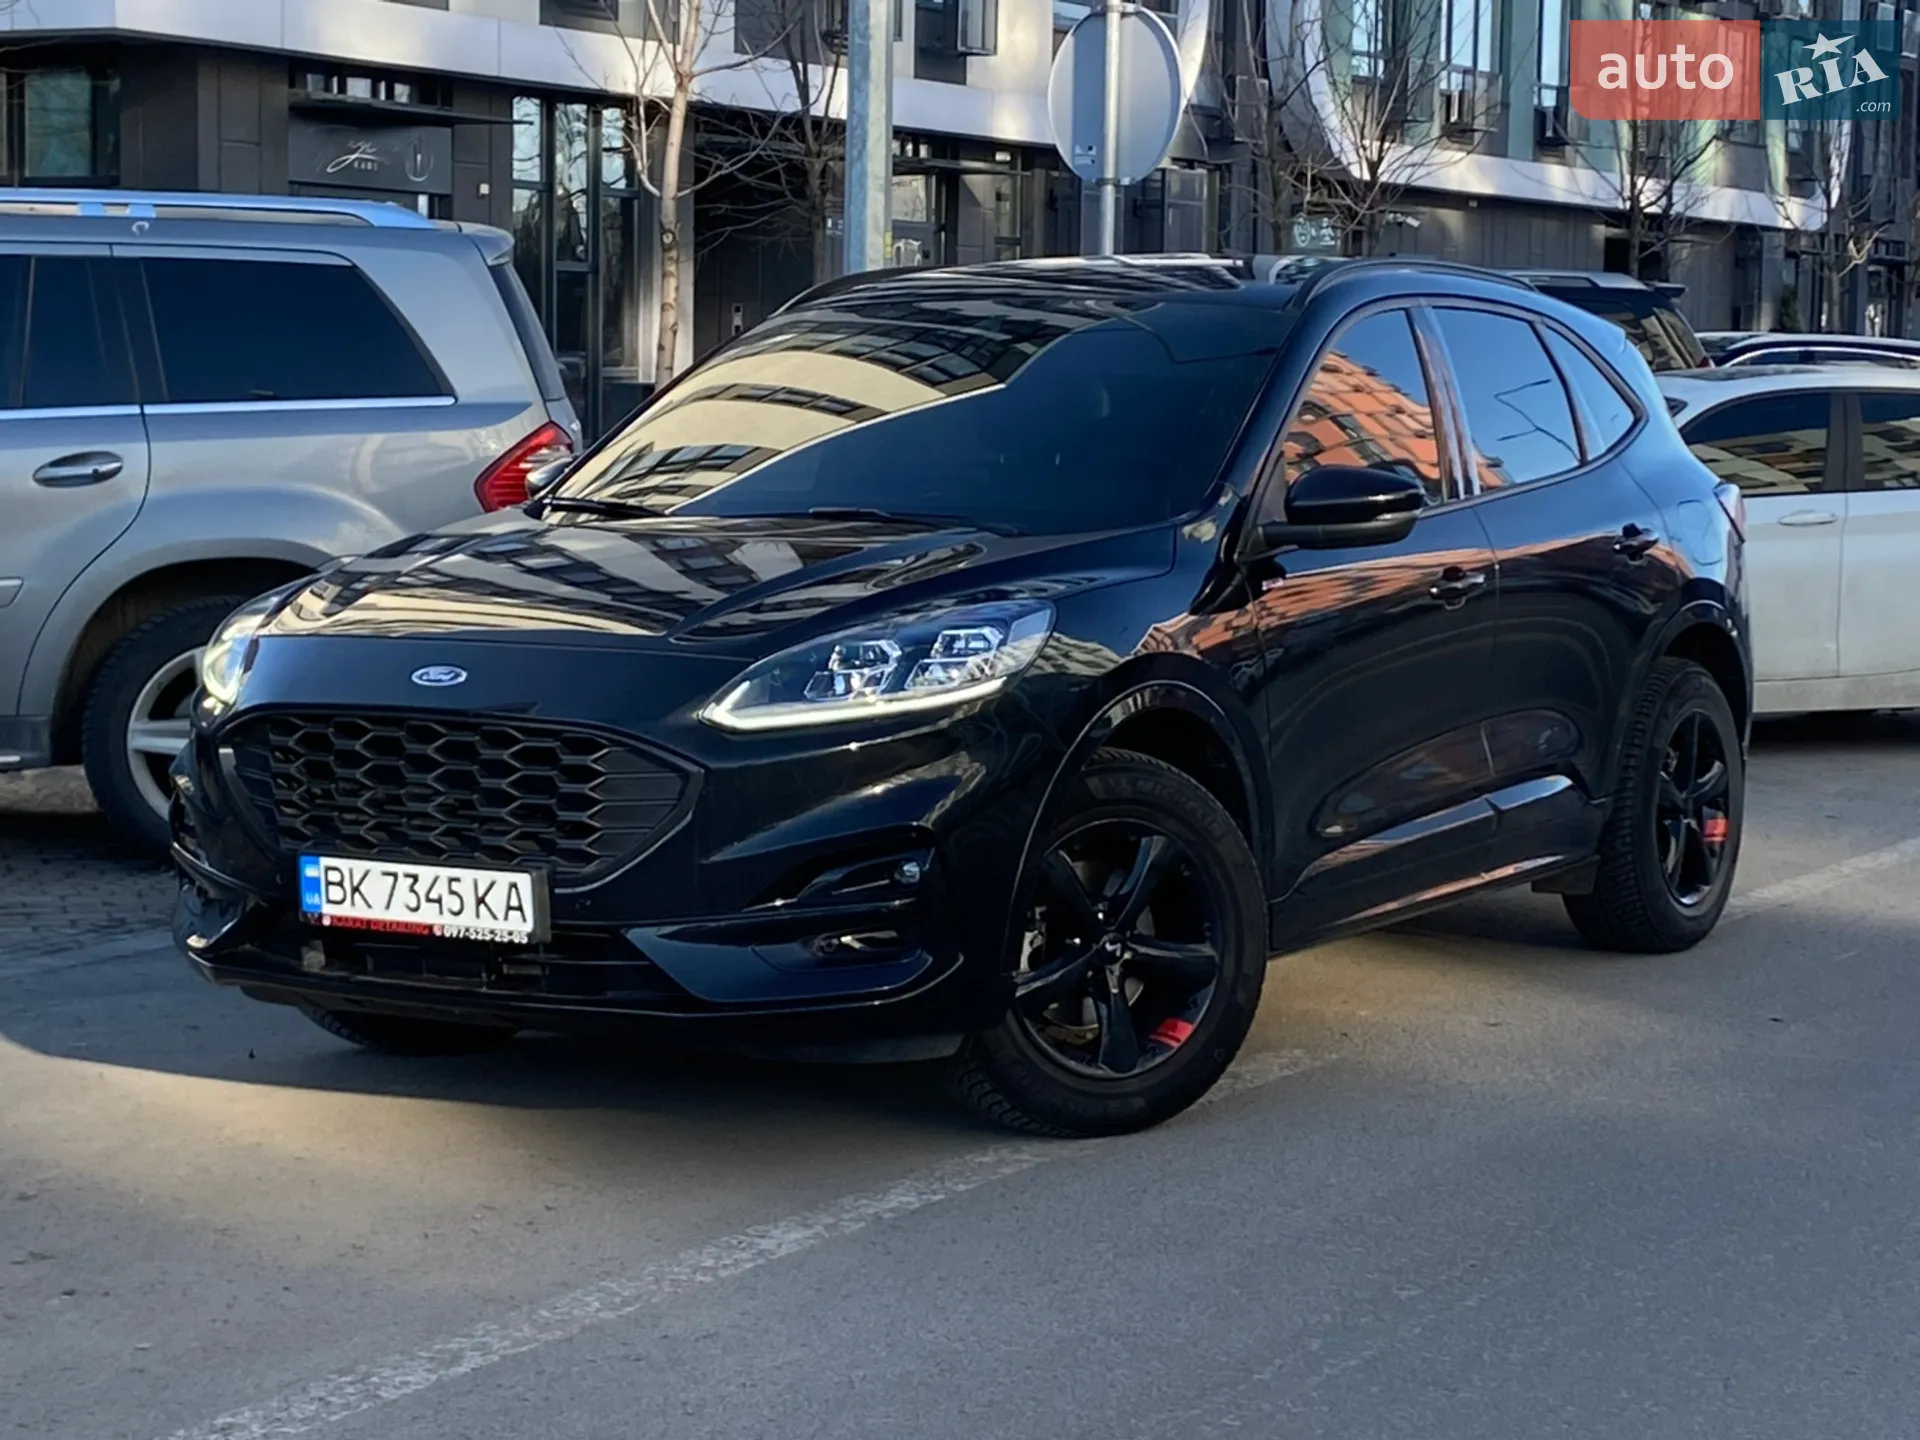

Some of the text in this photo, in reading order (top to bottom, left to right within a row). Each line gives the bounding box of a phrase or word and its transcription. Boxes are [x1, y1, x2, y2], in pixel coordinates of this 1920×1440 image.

[323, 865, 528, 923] BK 7345 KA
